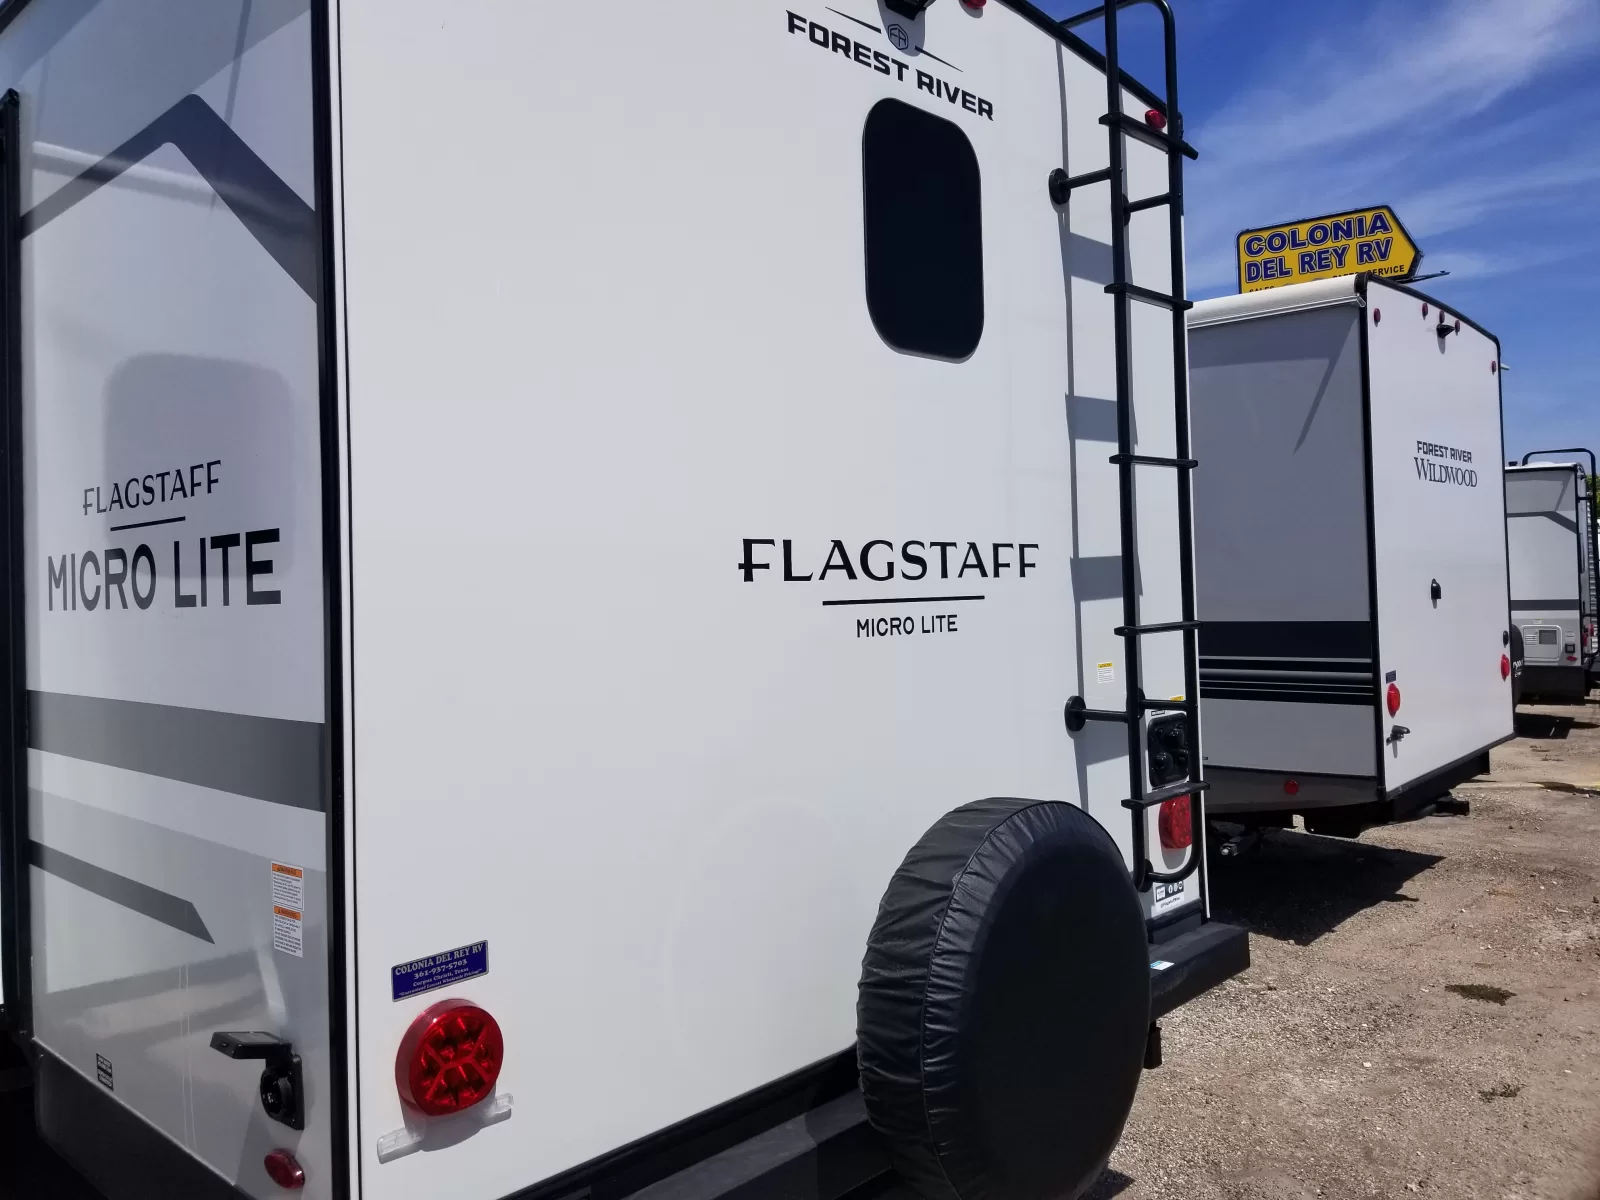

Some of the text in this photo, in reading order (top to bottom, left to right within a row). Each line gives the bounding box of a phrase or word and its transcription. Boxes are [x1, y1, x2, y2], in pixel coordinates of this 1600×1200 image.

[786, 10, 994, 121] FOREST RIVER
[1245, 212, 1392, 257] COLONIA
[1245, 237, 1393, 283] DEL REY RV
[1416, 440, 1472, 463] FOREST RIVER
[82, 459, 222, 516] FLAGSTAFF
[1413, 456, 1478, 487] WILDWOOD
[48, 528, 282, 611] MICRO LITE
[738, 538, 1040, 583] FLAGSTAFF
[856, 614, 958, 638] MICRO LITE
[395, 943, 484, 976] COLONIA DEL REY RV
[413, 976, 433, 987] Corpus
[454, 966, 469, 976] Texas
[414, 959, 468, 980] 361-937-5703
